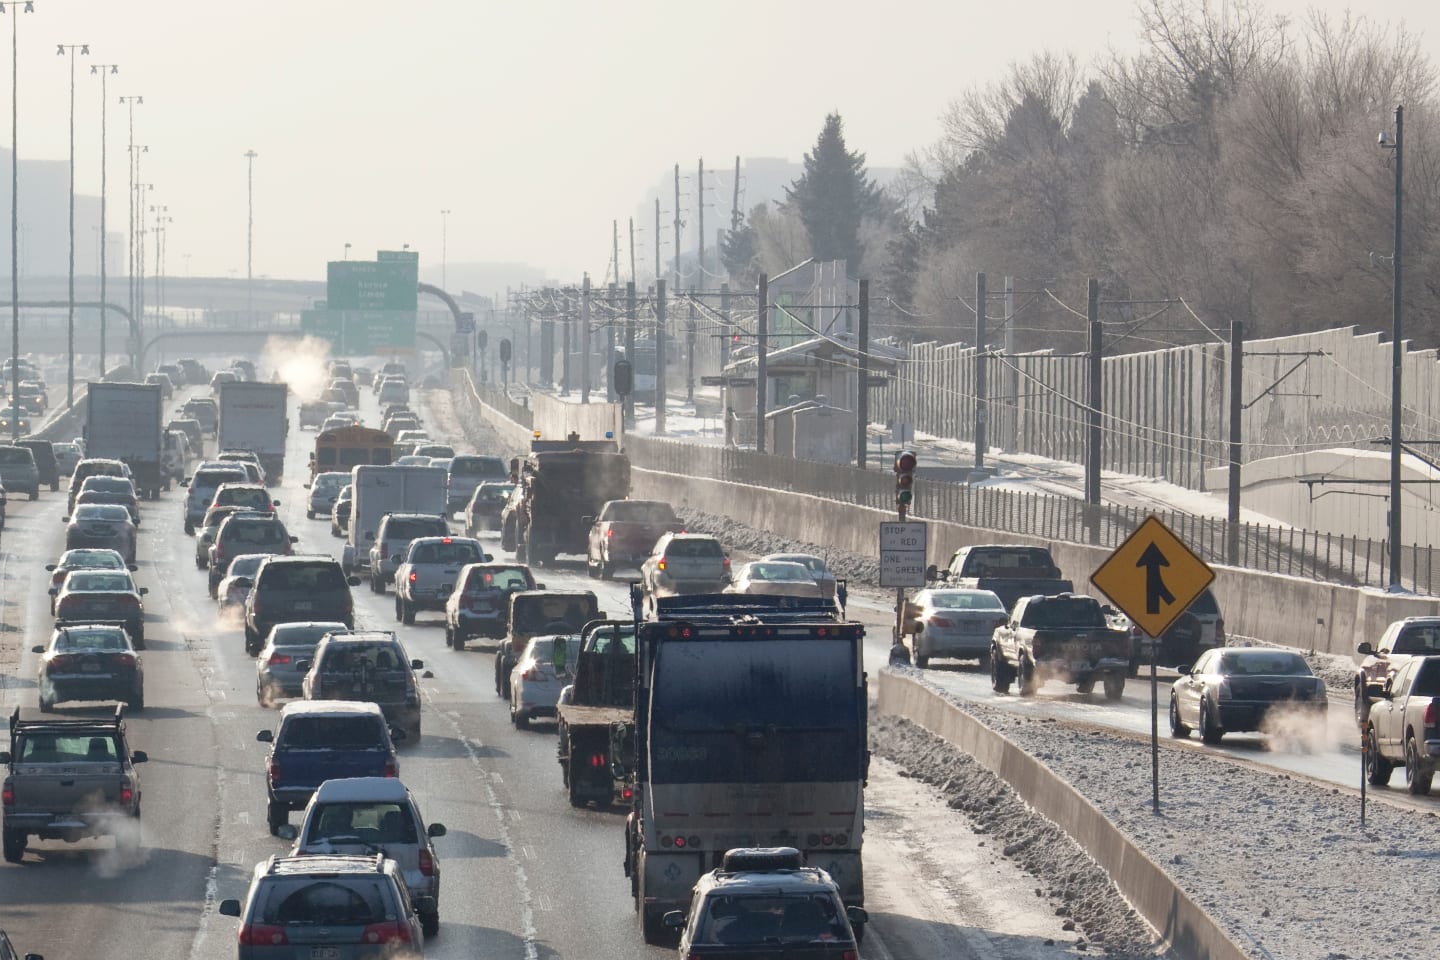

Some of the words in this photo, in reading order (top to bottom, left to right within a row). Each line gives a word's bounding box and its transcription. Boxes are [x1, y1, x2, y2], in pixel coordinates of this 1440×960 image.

[884, 527, 906, 535] STOP
[900, 538, 917, 546] RED
[884, 555, 901, 563] ONE
[895, 567, 923, 575] GREEN
